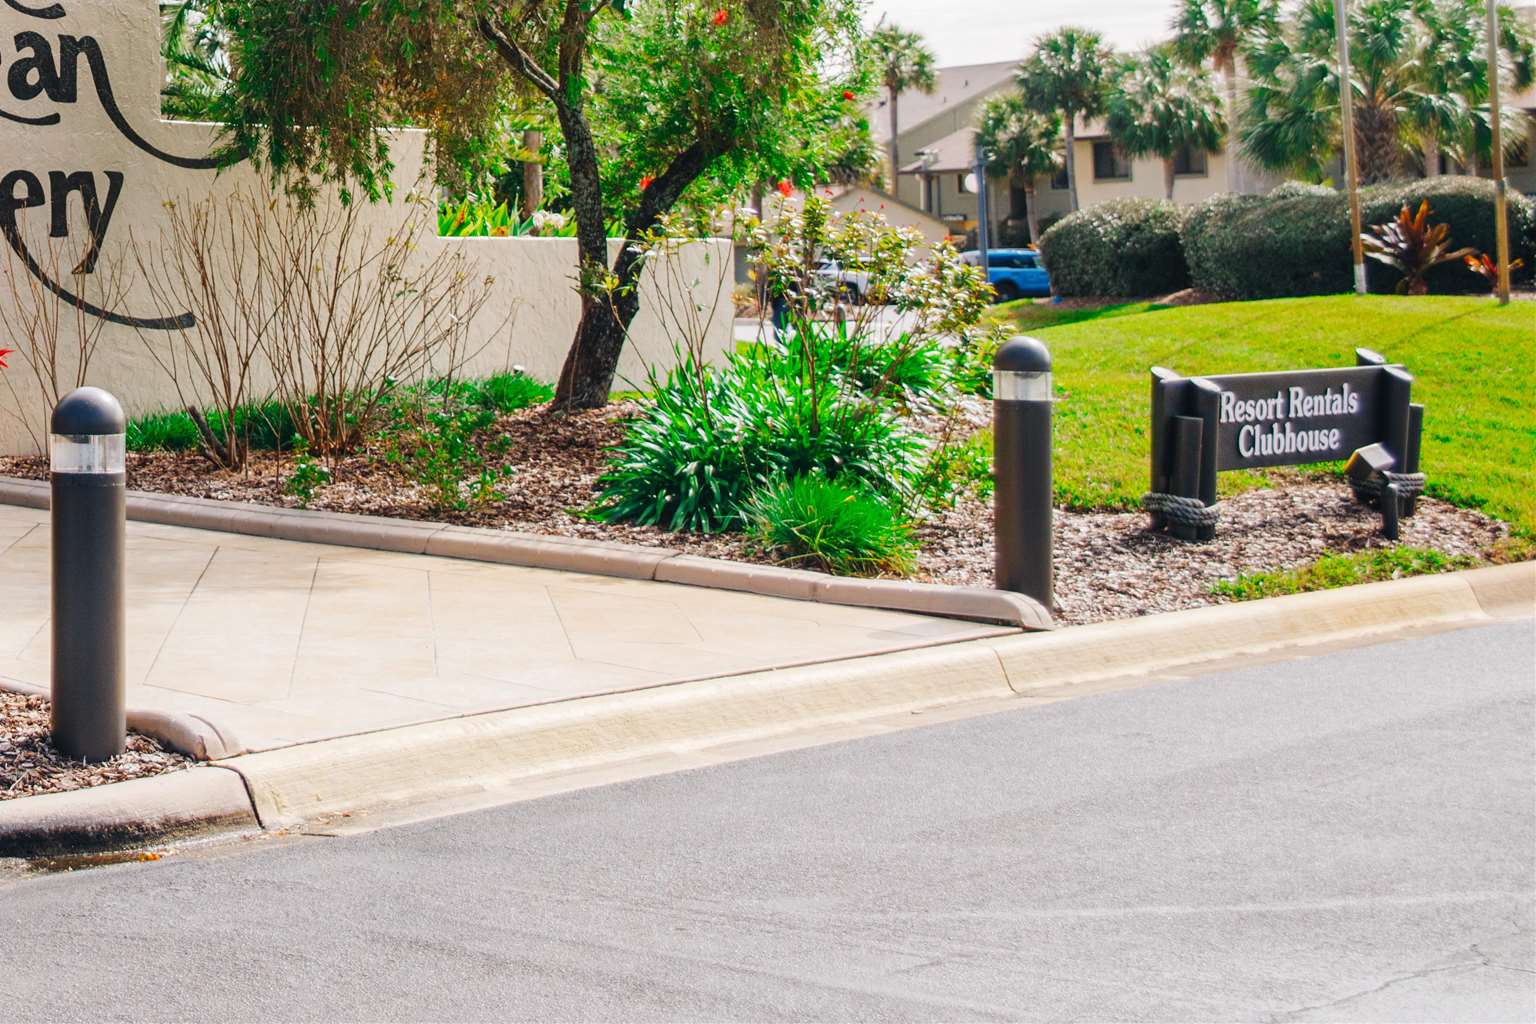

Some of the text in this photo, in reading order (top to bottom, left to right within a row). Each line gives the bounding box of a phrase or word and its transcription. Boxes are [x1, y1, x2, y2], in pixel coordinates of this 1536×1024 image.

[1220, 383, 1359, 423] Resort Rentals
[1238, 422, 1341, 458] Clubhouse
